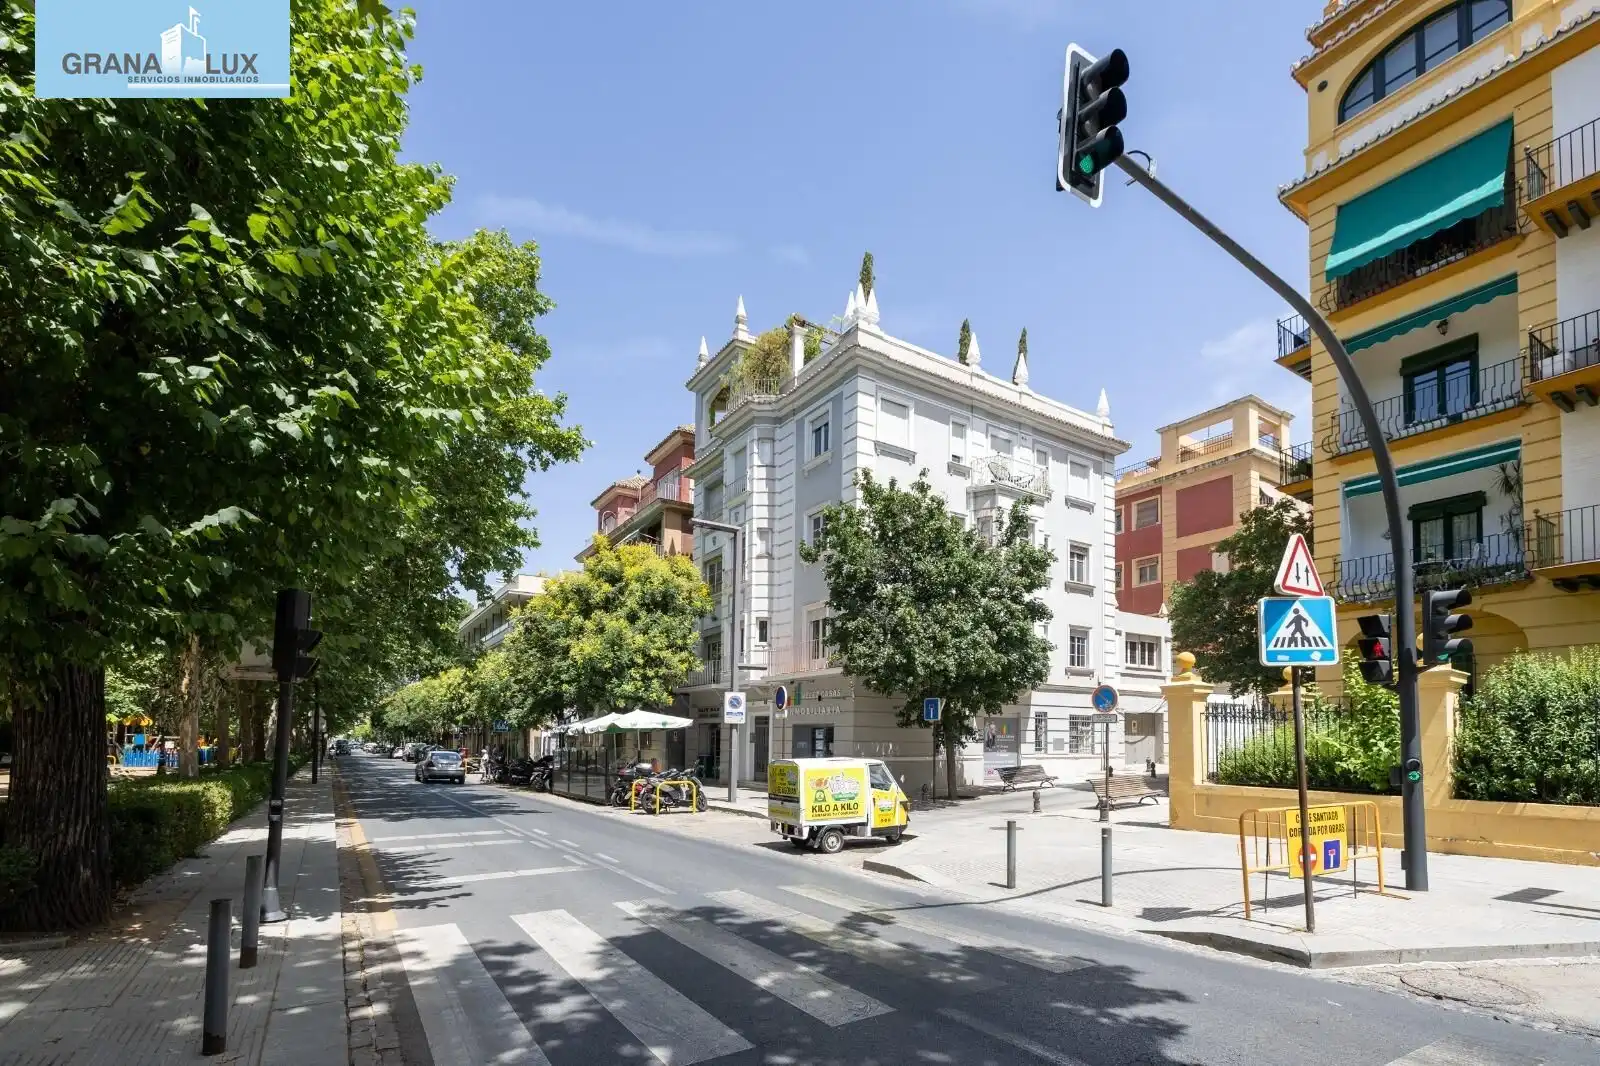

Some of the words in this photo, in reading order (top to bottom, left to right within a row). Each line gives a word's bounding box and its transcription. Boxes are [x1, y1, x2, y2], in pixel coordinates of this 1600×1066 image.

[811, 804, 831, 814] KILO
[833, 803, 839, 812] A
[840, 802, 859, 812] KILO
[1313, 811, 1338, 822] SANTIAGO
[1317, 825, 1328, 836] POR
[1328, 824, 1345, 834] OBRAS
